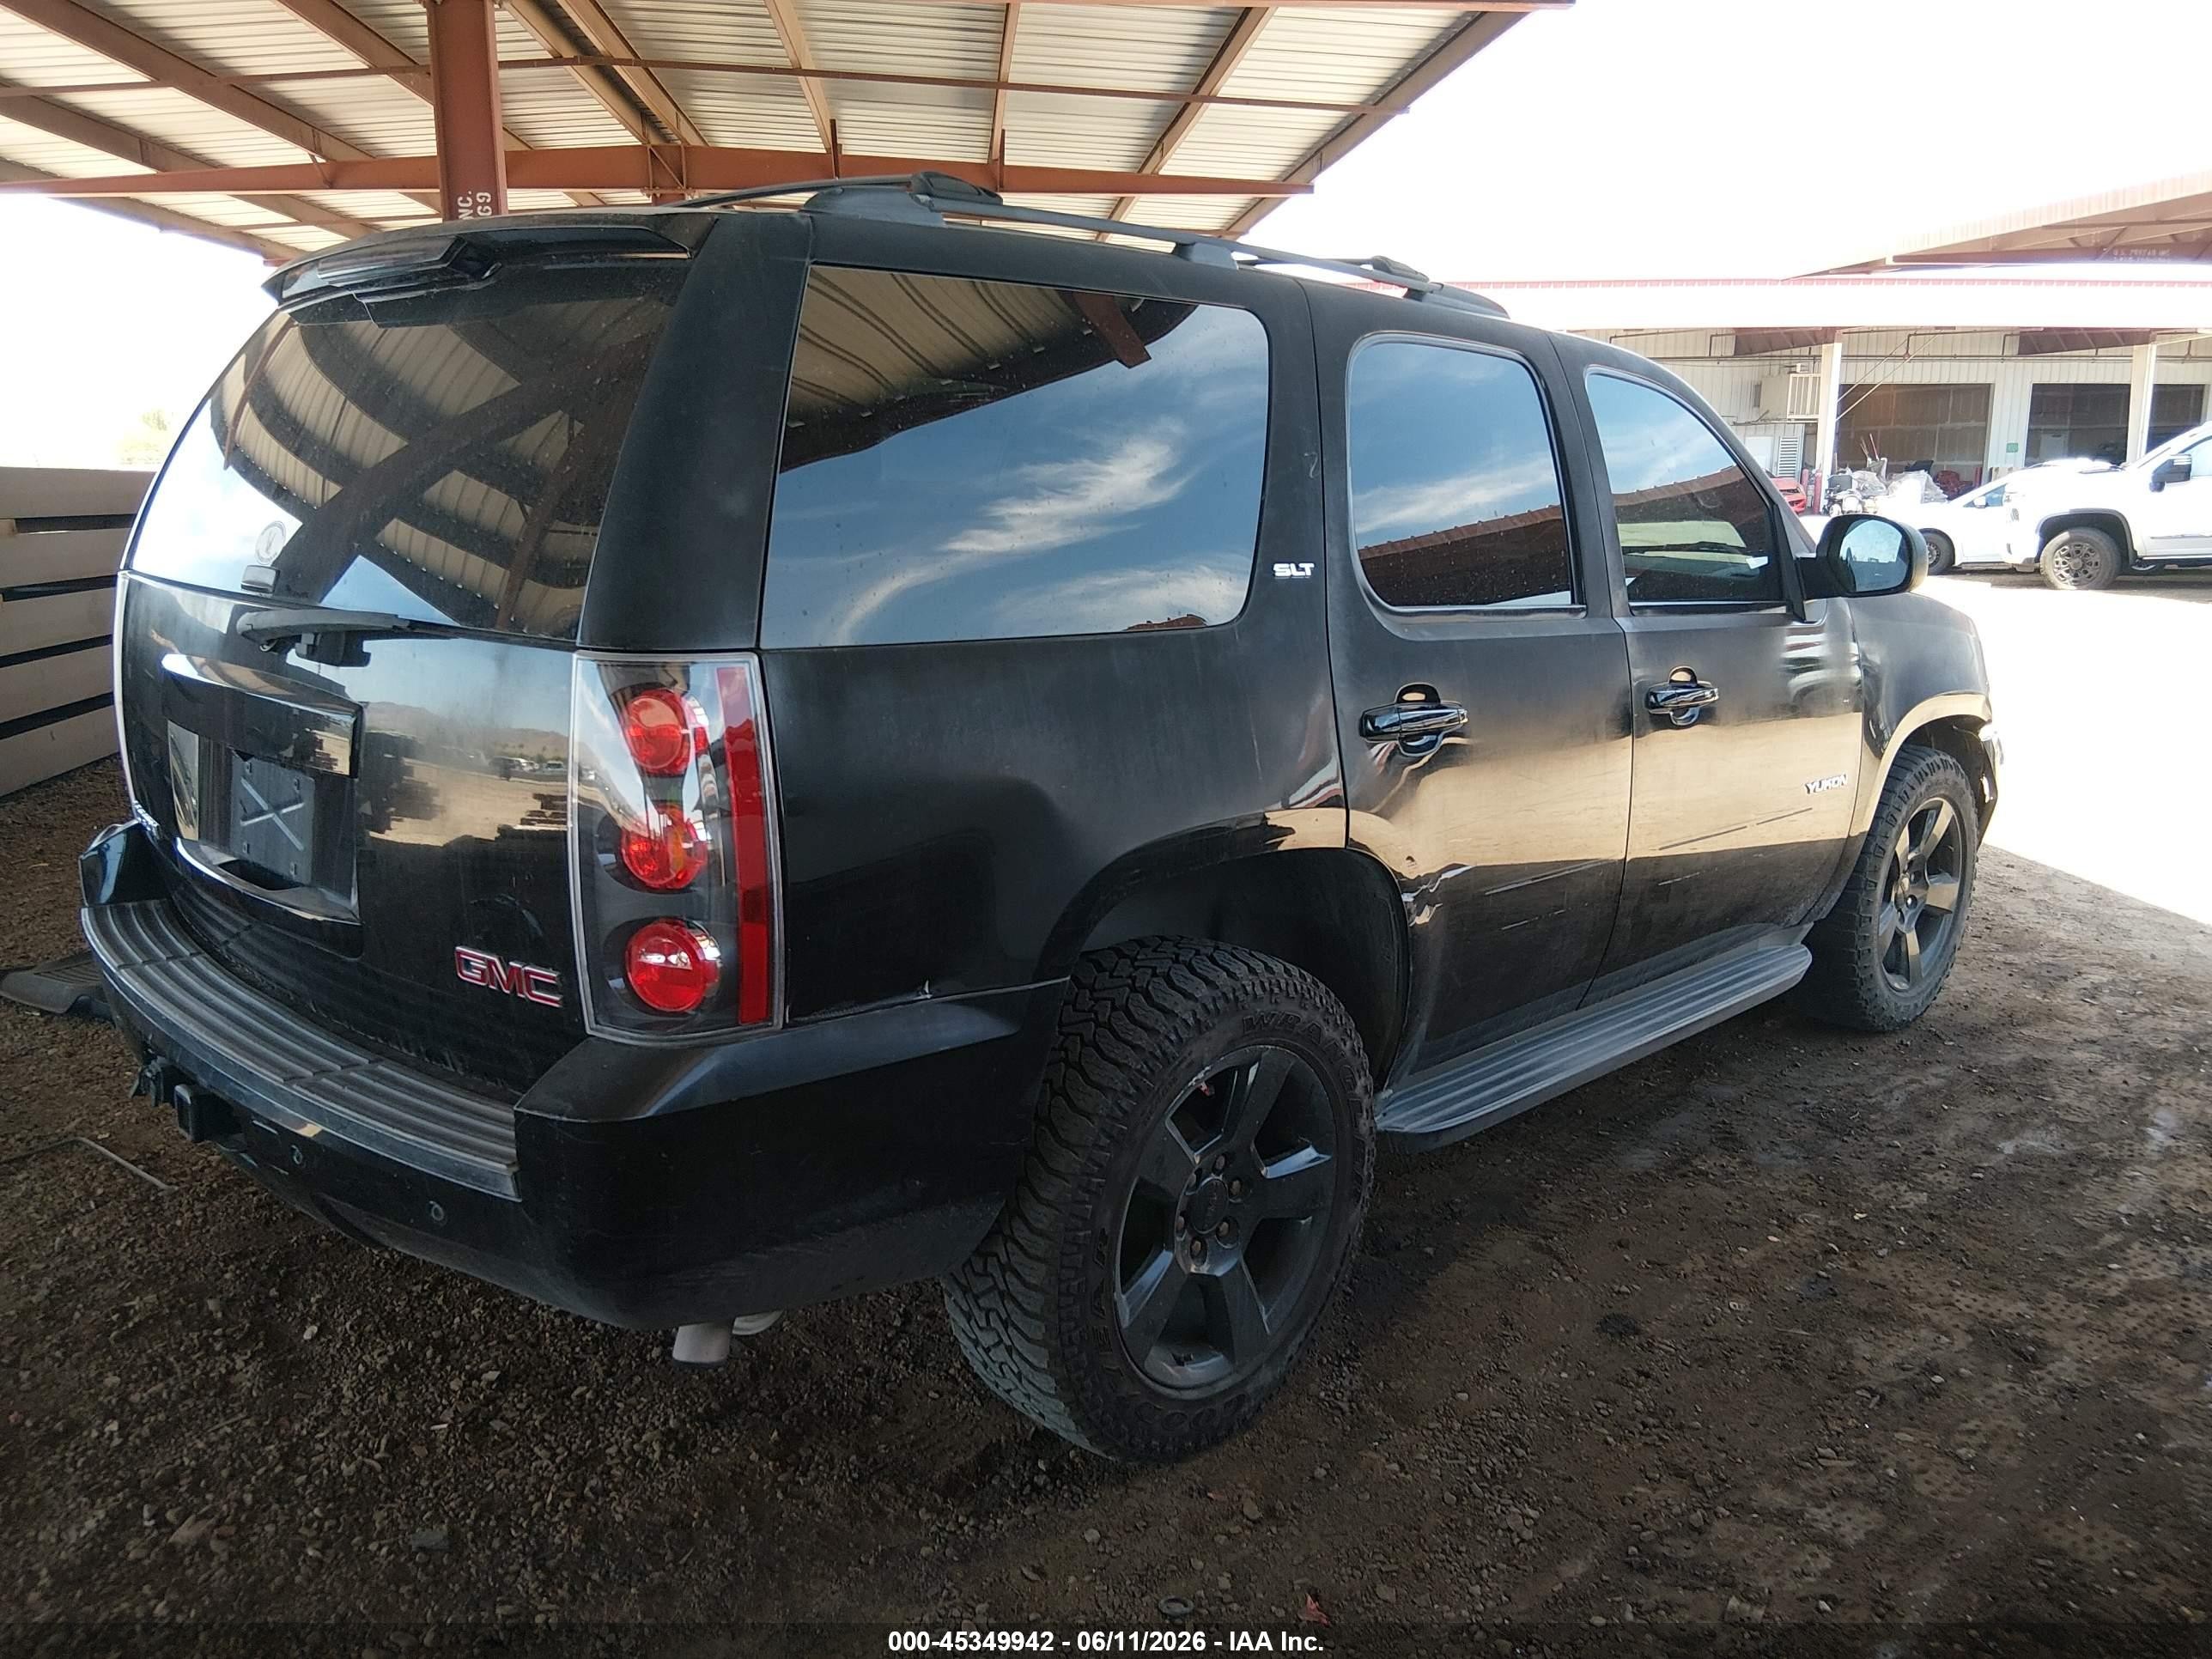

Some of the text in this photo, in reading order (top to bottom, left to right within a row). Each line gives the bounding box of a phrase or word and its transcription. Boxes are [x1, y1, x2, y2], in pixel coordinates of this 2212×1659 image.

[1273, 562, 1316, 577] SLT
[1804, 772, 1849, 794] YUKON
[454, 945, 563, 1008] GMC
